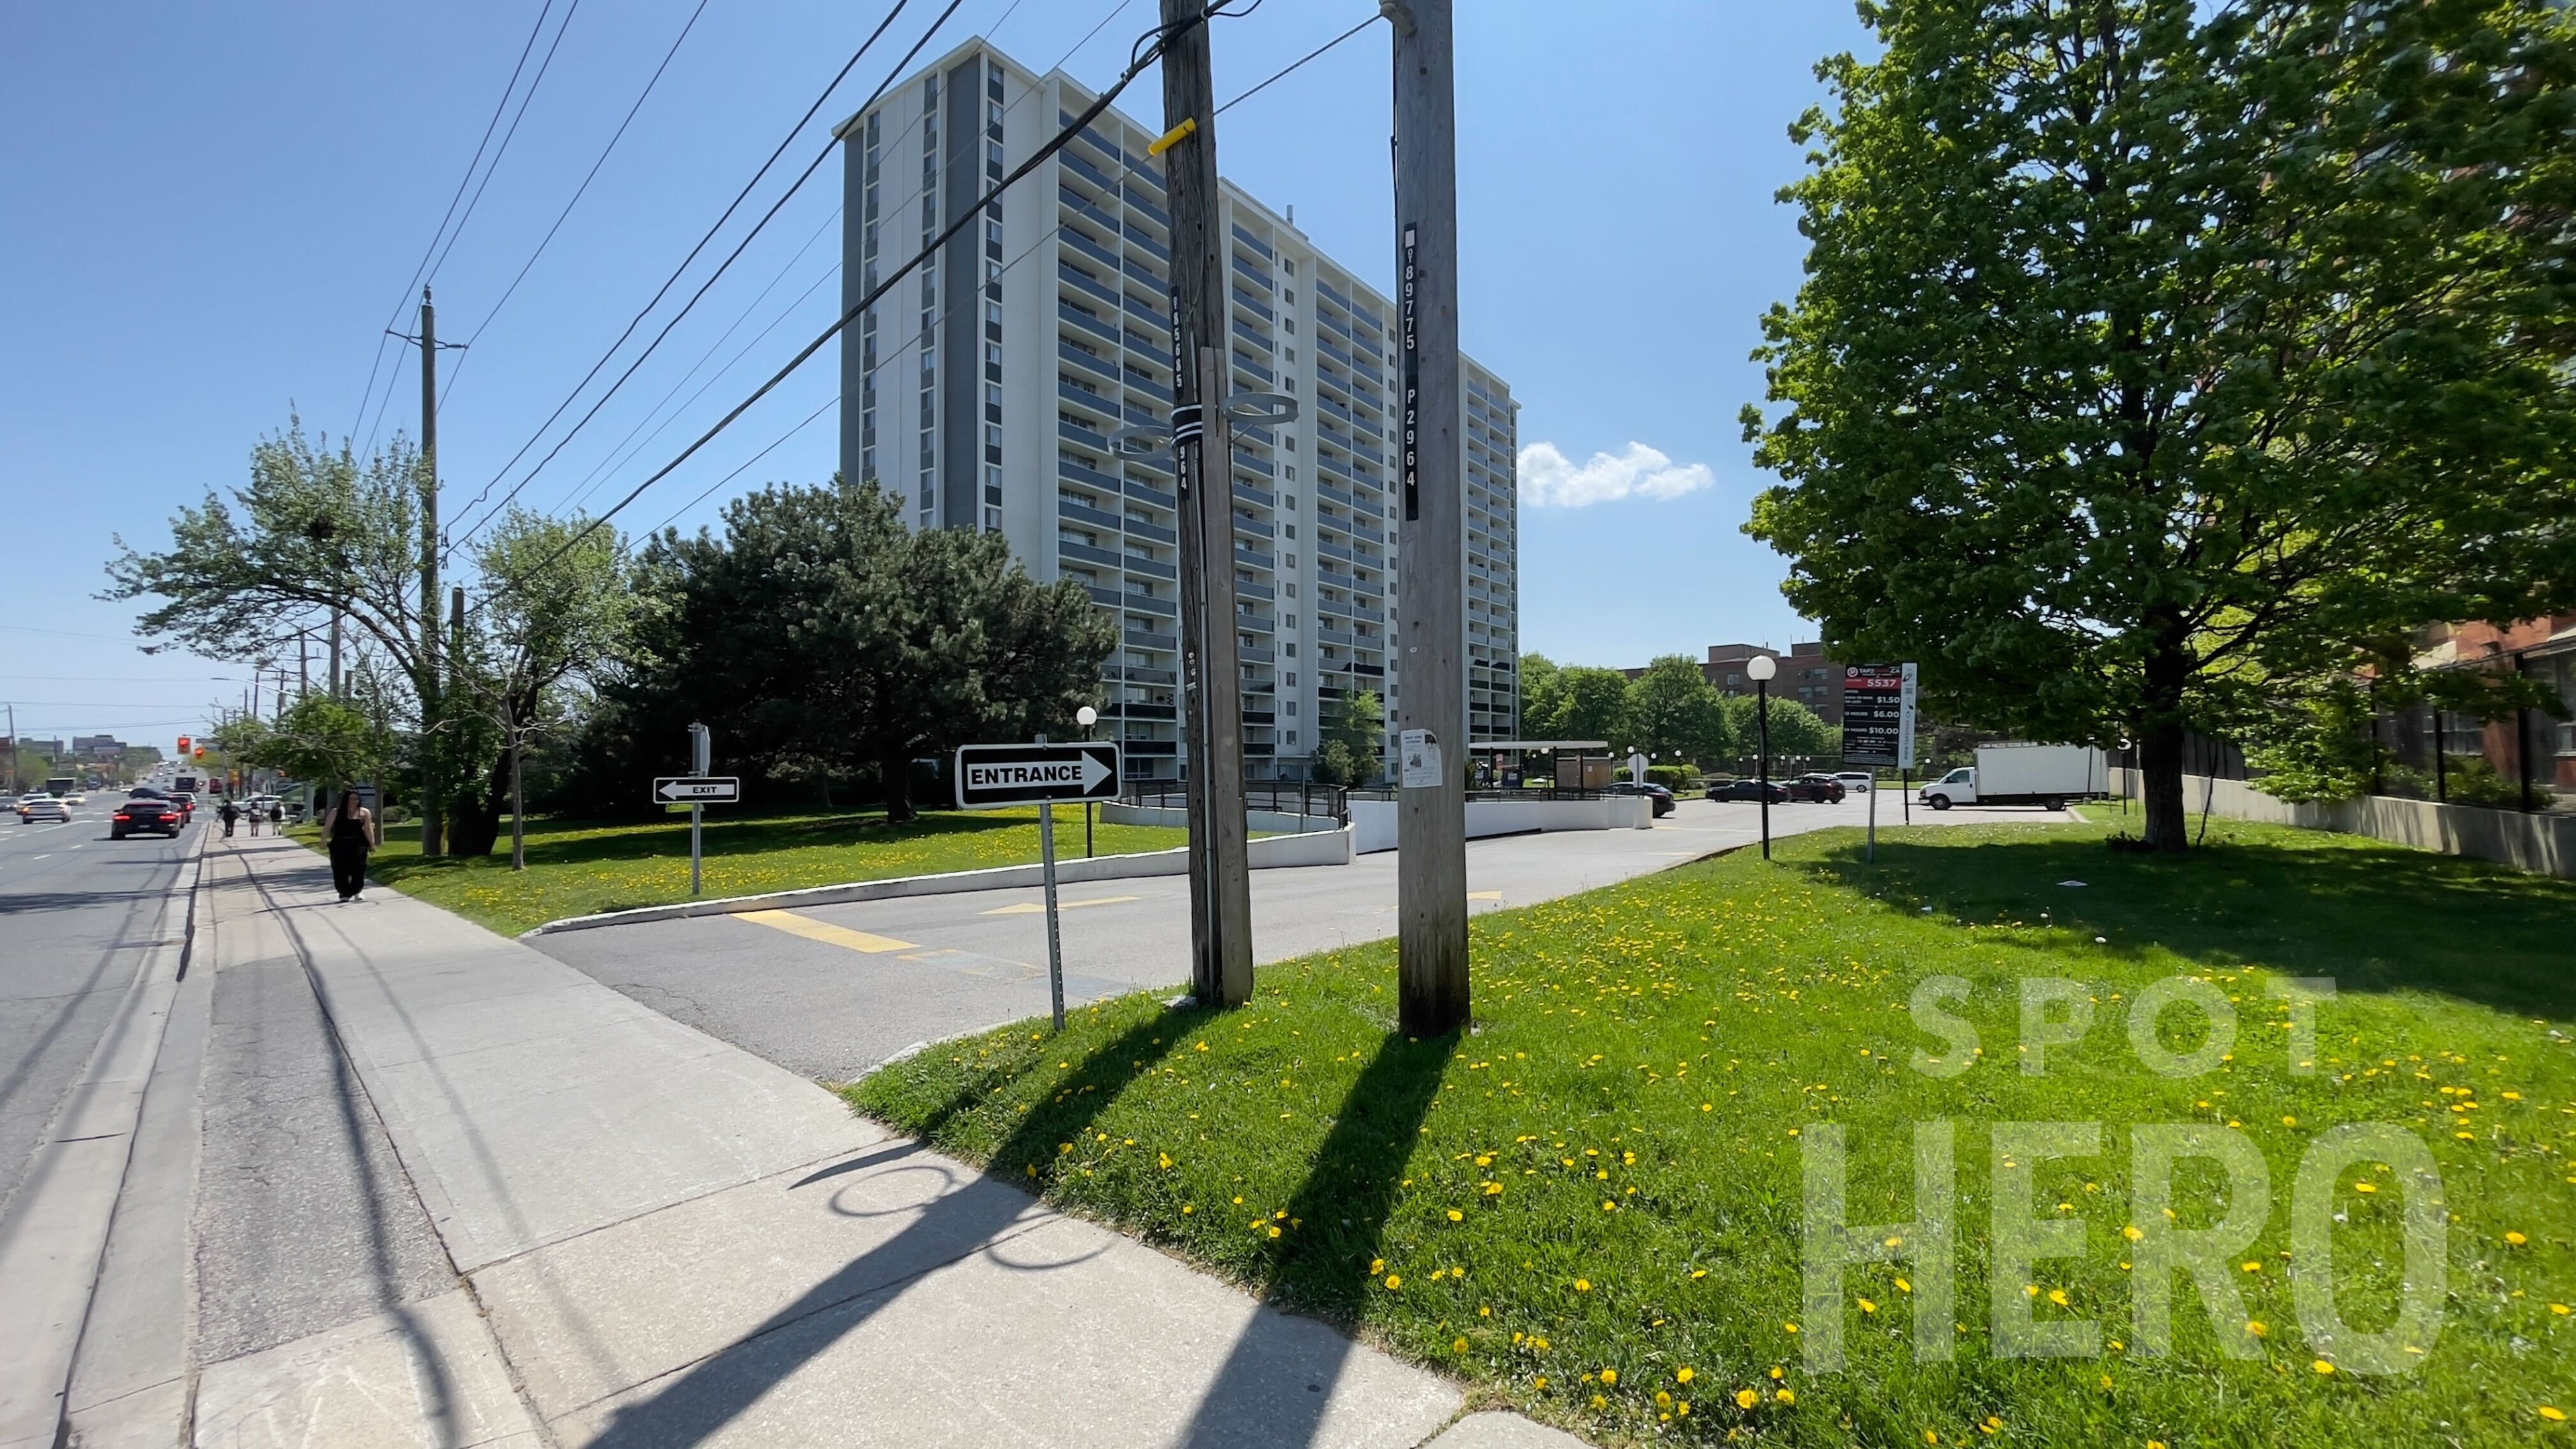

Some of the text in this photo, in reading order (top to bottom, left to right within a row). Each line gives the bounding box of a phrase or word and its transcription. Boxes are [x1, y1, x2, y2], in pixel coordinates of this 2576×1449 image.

[1867, 679, 1897, 687] 5537
[1868, 727, 1899, 735] $10.00
[971, 765, 1082, 785] ENTRANCE
